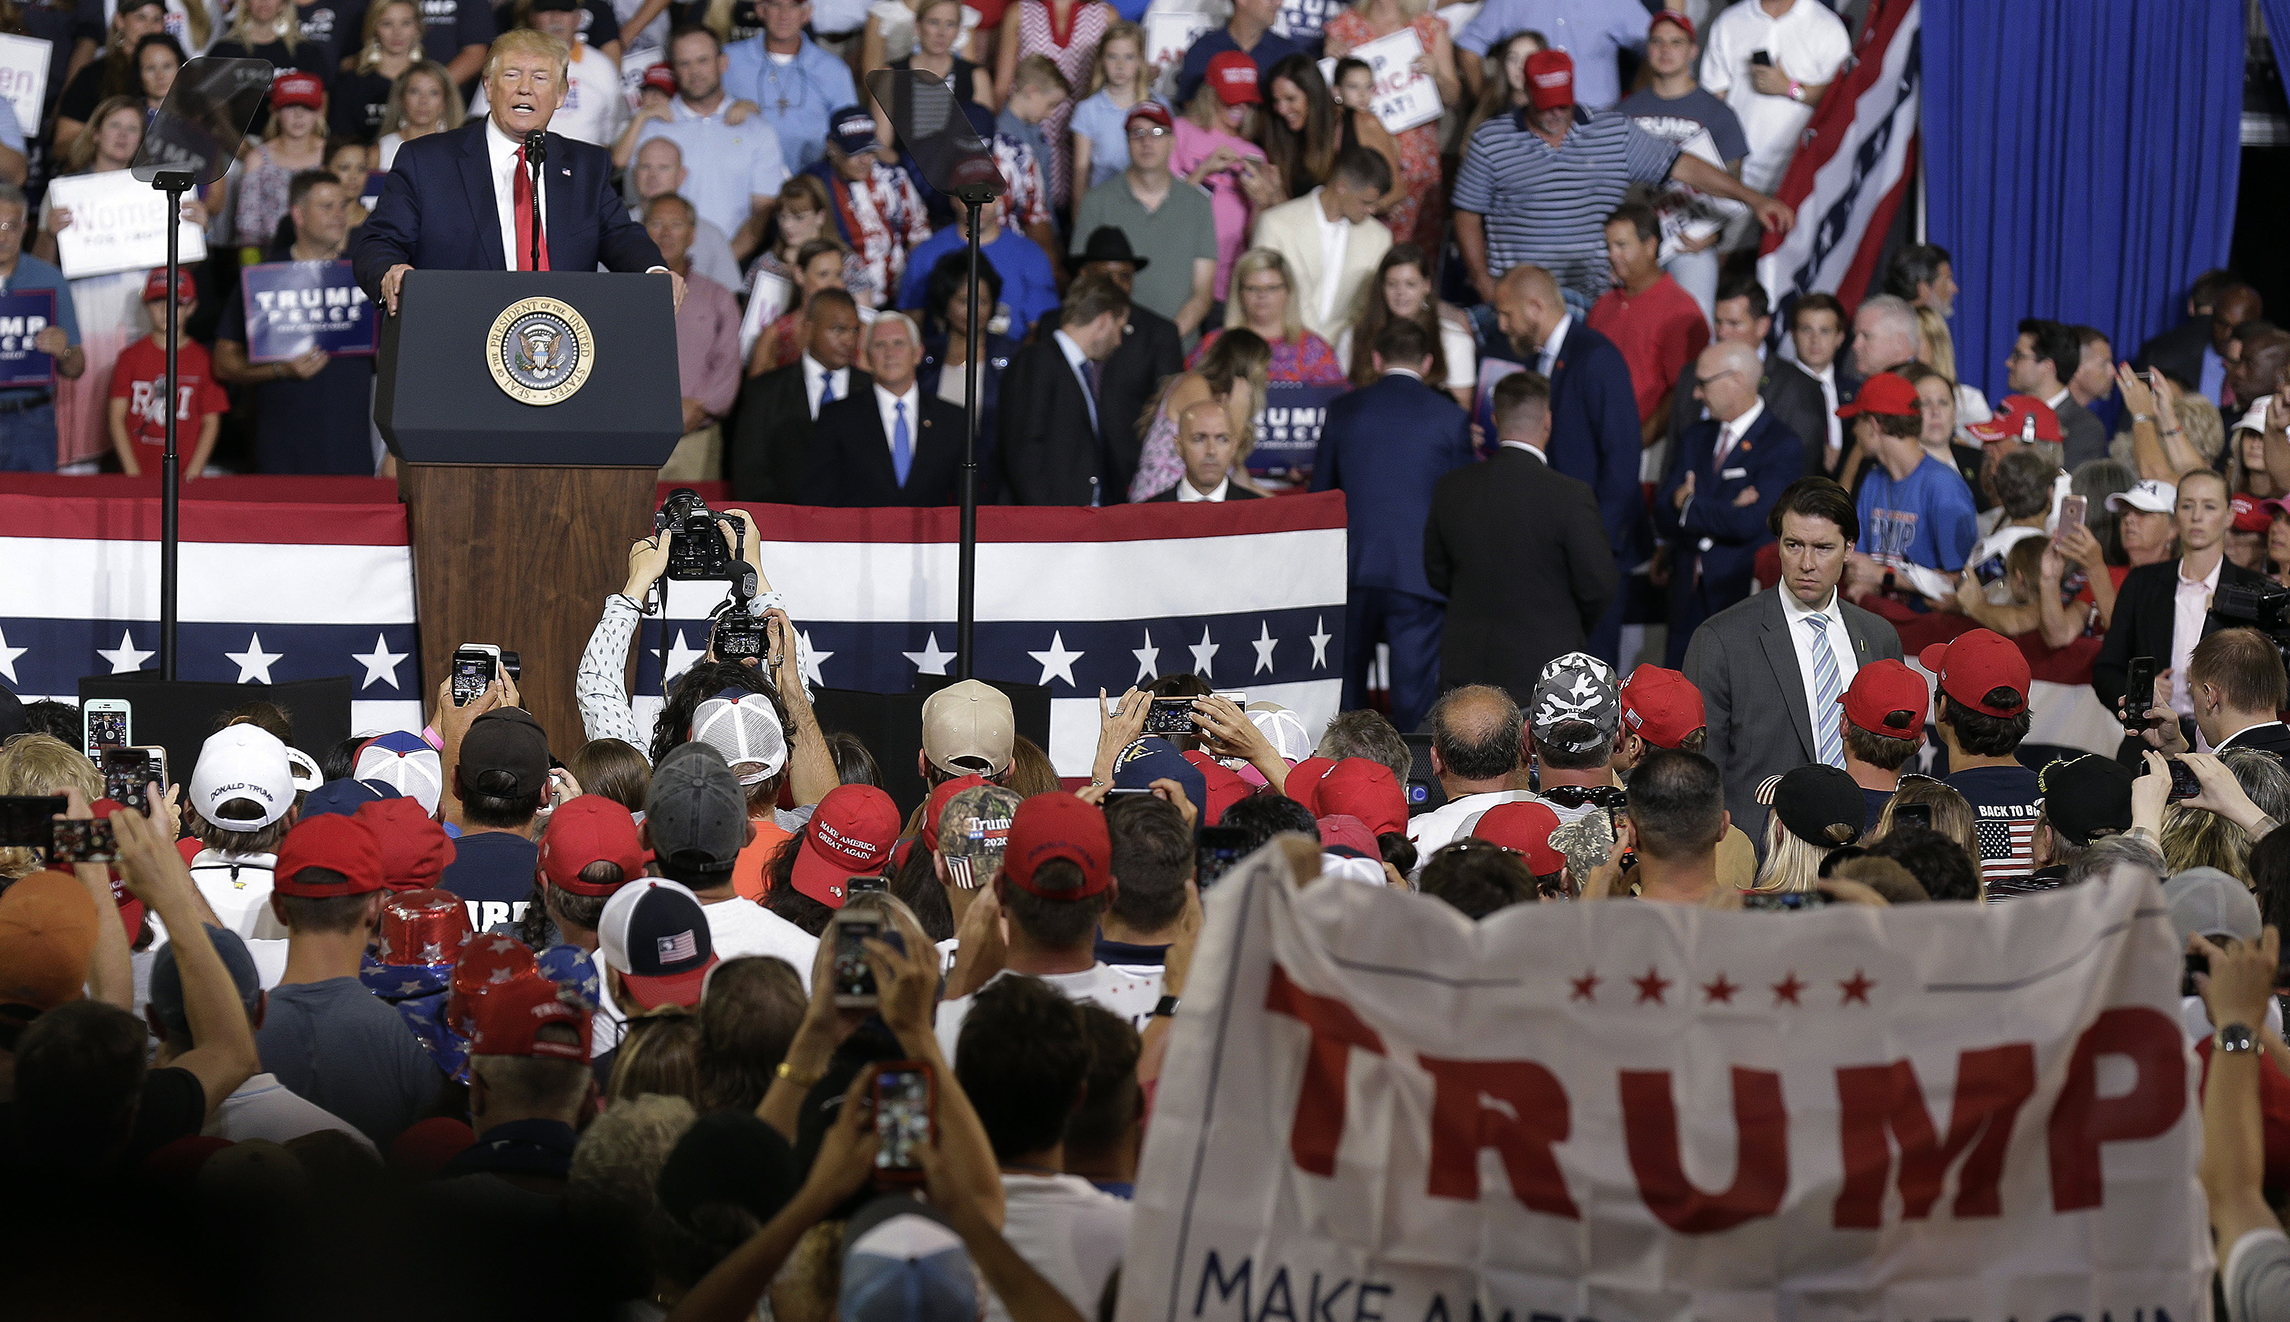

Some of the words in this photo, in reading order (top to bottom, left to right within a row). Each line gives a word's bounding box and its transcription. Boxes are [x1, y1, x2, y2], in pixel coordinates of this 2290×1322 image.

[255, 286, 369, 312] TRUMP
[491, 301, 538, 348] PRESIDENT
[568, 314, 590, 358] UNITED
[505, 377, 531, 399] SEAL
[549, 367, 586, 399] STATES
[211, 782, 245, 802] DONALD
[247, 783, 274, 802] TRUMP
[1978, 806, 2009, 817] BACK
[2009, 805, 2023, 817] TO
[818, 831, 843, 850] GREAT
[843, 847, 872, 860] AGAIN
[819, 820, 839, 839] MAKE
[839, 835, 877, 852] AMERICA
[1266, 962, 2187, 1236] TRUMP
